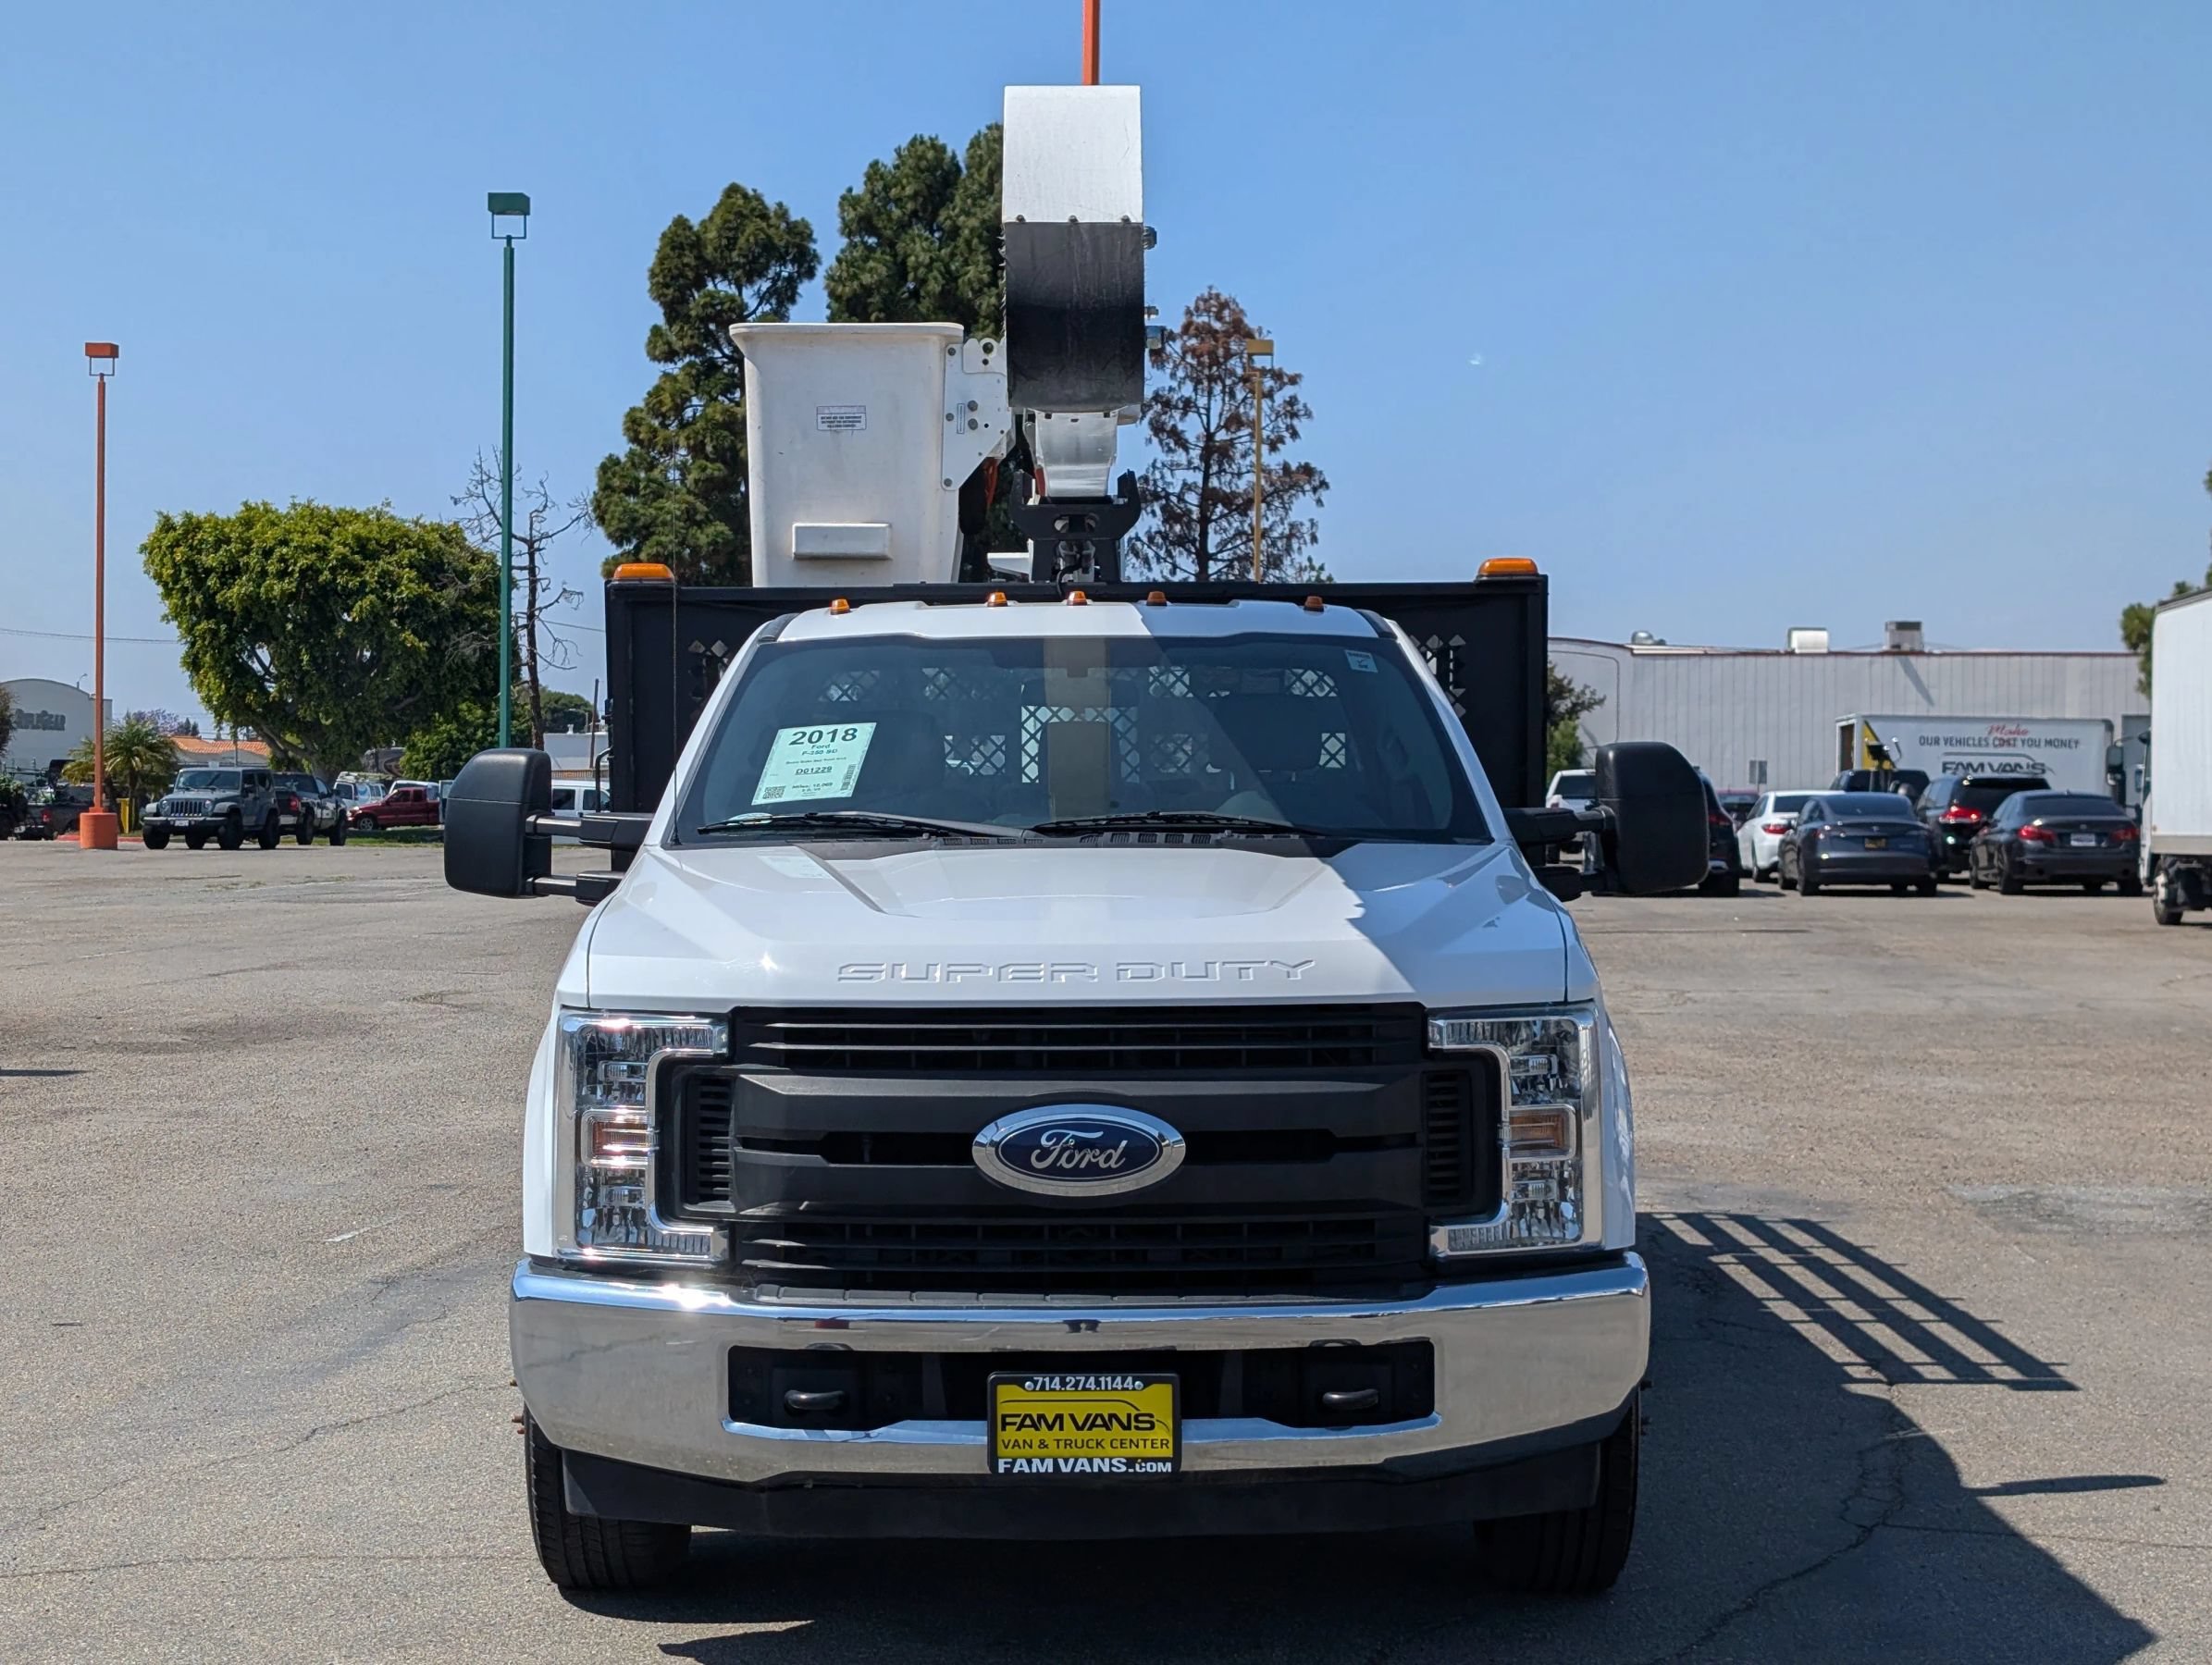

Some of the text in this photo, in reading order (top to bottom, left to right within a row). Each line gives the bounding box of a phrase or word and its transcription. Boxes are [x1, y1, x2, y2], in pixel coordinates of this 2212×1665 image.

[788, 727, 858, 746] 2018
[1919, 735, 2080, 749] OUR VEHICLES COST YOU MONEY
[837, 959, 1316, 983] SUPER DUTY
[1031, 1128, 1126, 1169] Ford
[1033, 1376, 1133, 1391] 714.274.1144
[1002, 1438, 1170, 1449] VAN & TRUCK CENTER
